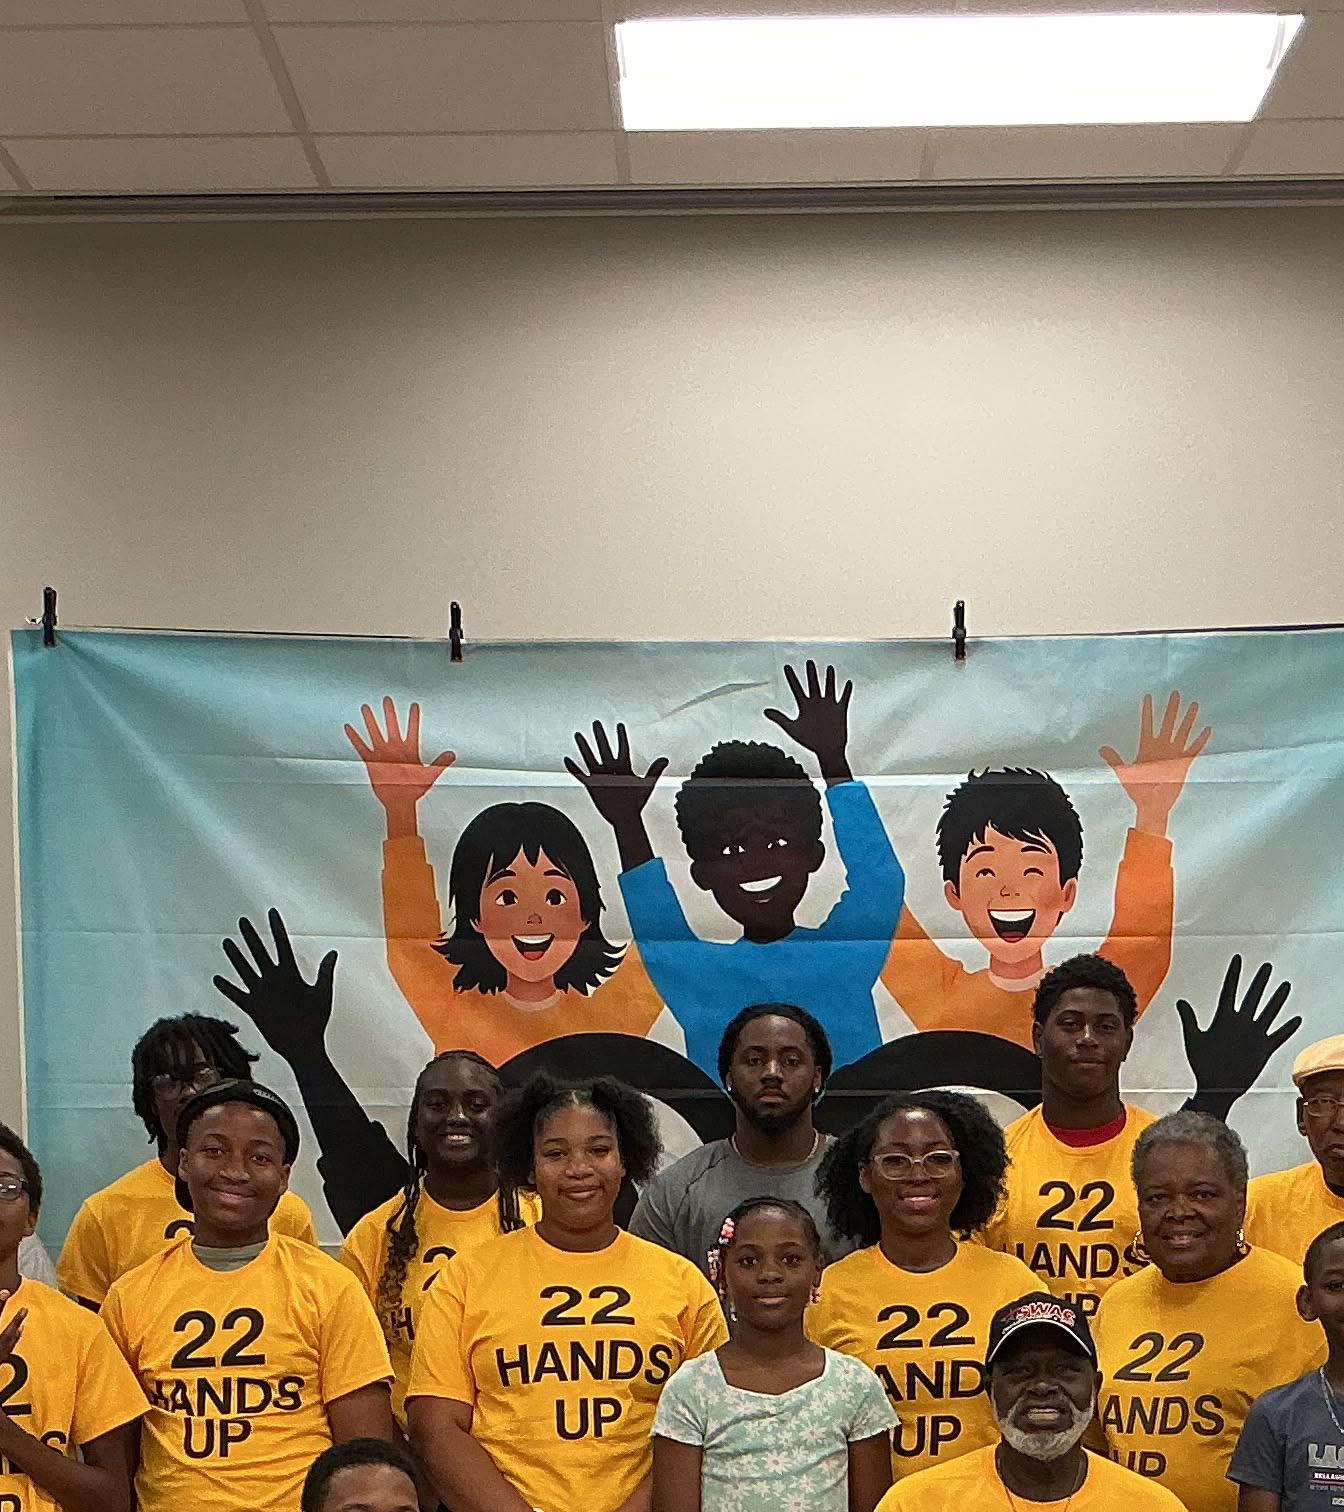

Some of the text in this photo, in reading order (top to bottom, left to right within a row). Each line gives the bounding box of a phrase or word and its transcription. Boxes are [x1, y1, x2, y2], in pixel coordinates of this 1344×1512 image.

[1036, 1180, 1115, 1232] 22
[540, 1285, 636, 1326] 22
[876, 1302, 976, 1350] 22
[171, 1307, 267, 1369] 22
[1113, 1332, 1204, 1382] 22
[495, 1340, 674, 1386] HANDS
[184, 1417, 253, 1459] UP
[556, 1397, 623, 1440] UP
[892, 1415, 962, 1458] UP
[1103, 1395, 1225, 1437] ANDS
